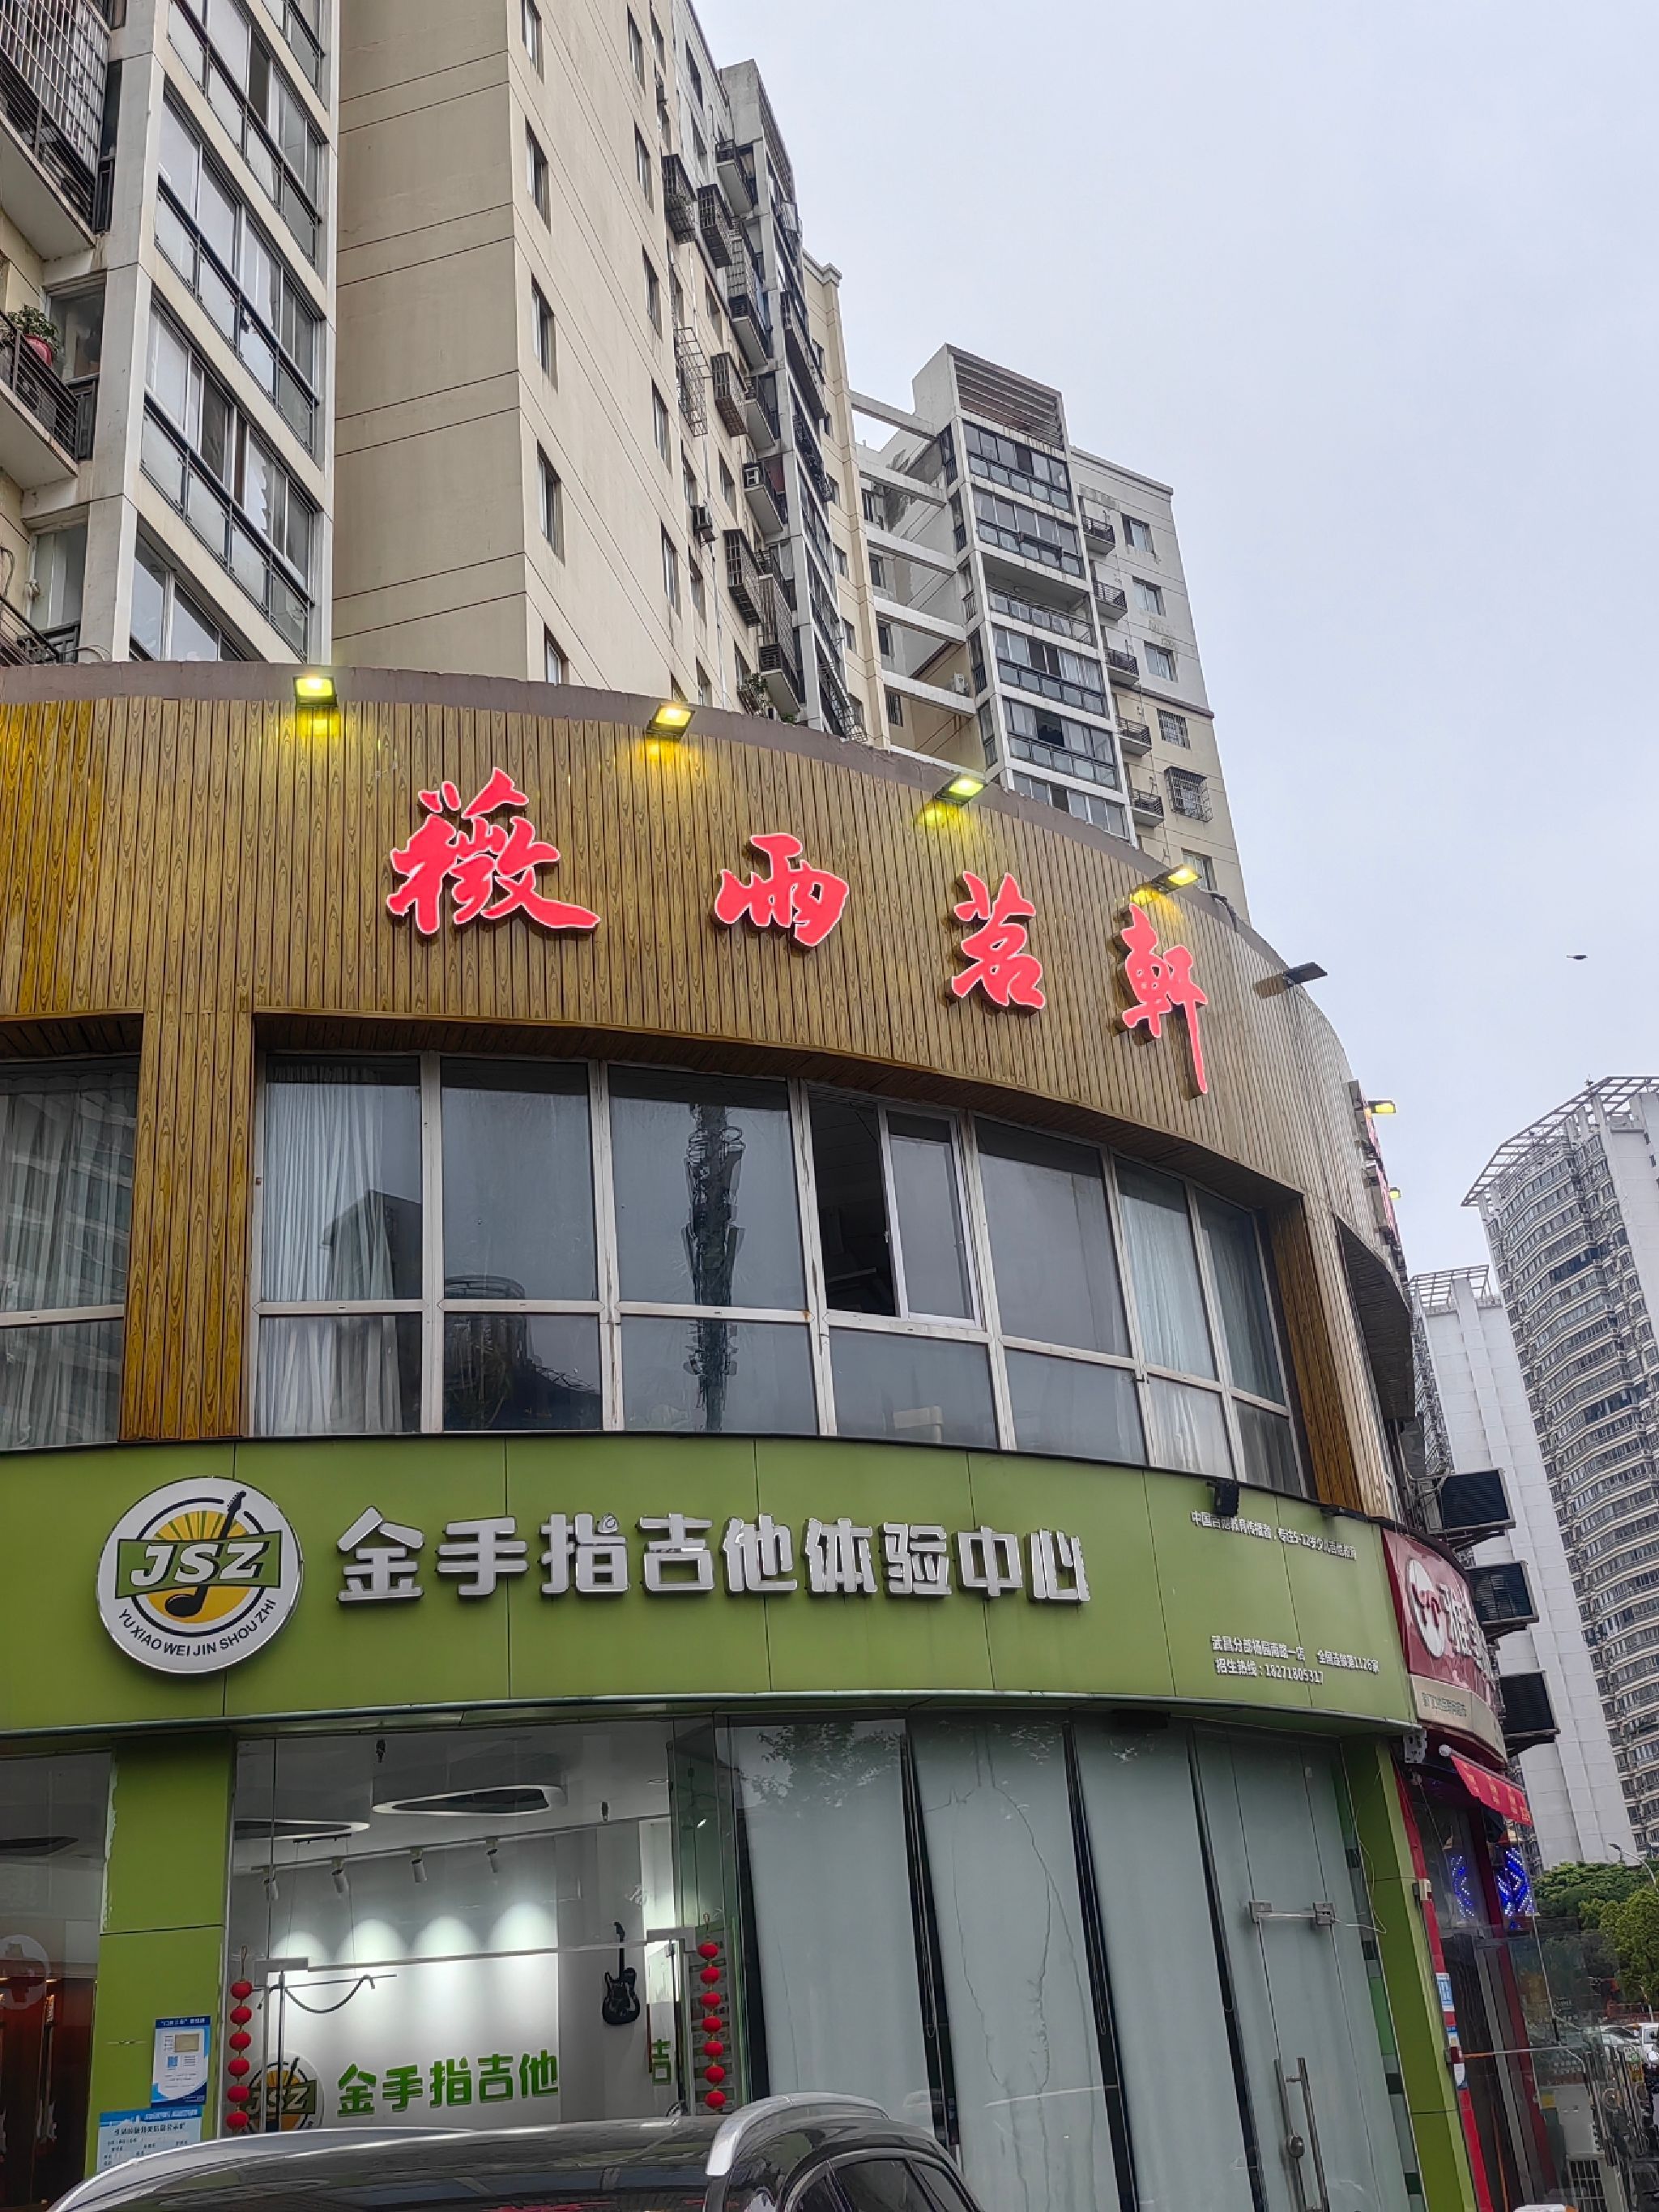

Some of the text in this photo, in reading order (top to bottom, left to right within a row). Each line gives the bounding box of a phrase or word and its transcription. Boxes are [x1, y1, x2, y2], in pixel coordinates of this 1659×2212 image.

[130, 1541, 269, 1586] JSZ
[337, 1505, 1091, 1603] 金手指吉他体验中心
[118, 1608, 135, 1629] YU
[130, 1625, 162, 1650] XIAO
[220, 1620, 258, 1650] SHOU
[255, 1599, 277, 1624] ZHI
[337, 2049, 559, 2118] 金手指吉他
